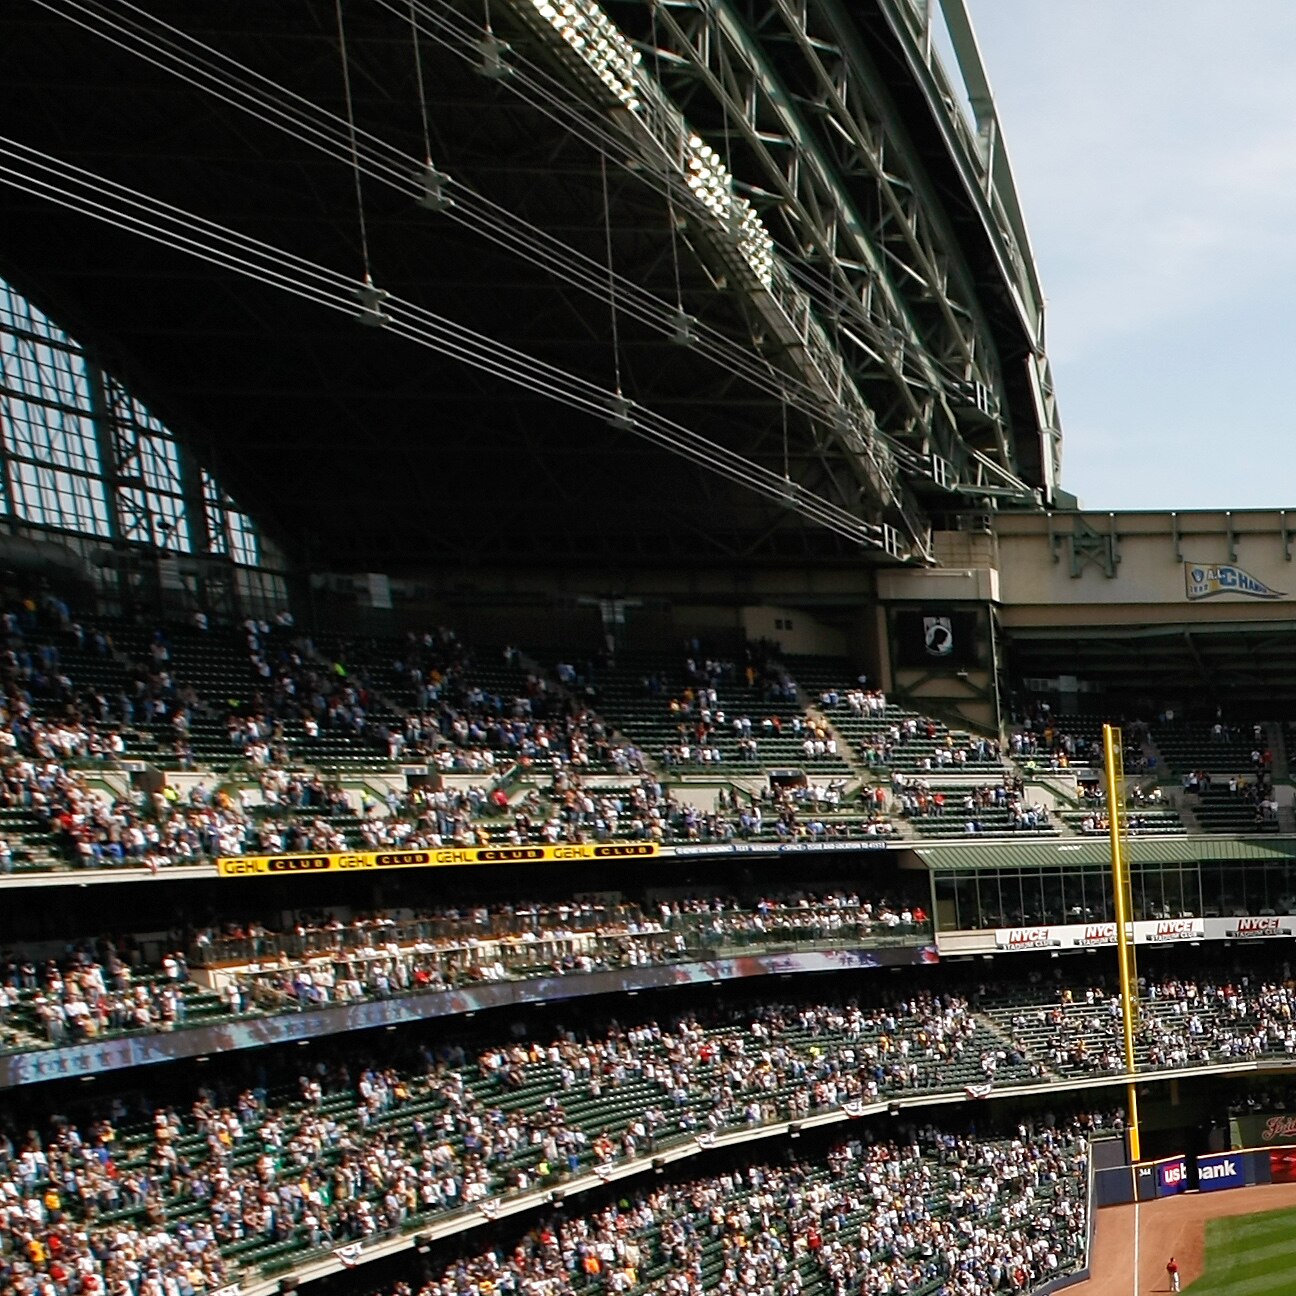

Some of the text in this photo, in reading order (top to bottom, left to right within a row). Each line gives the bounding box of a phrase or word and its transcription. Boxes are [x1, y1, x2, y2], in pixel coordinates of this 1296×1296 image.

[224, 846, 647, 874] GEHL CLUB GEHL CLUB GEHL CLUB GEHL CLUB
[1156, 921, 1194, 935] NYCE
[1237, 917, 1280, 931] NYCE
[1009, 929, 1048, 942] NYCE
